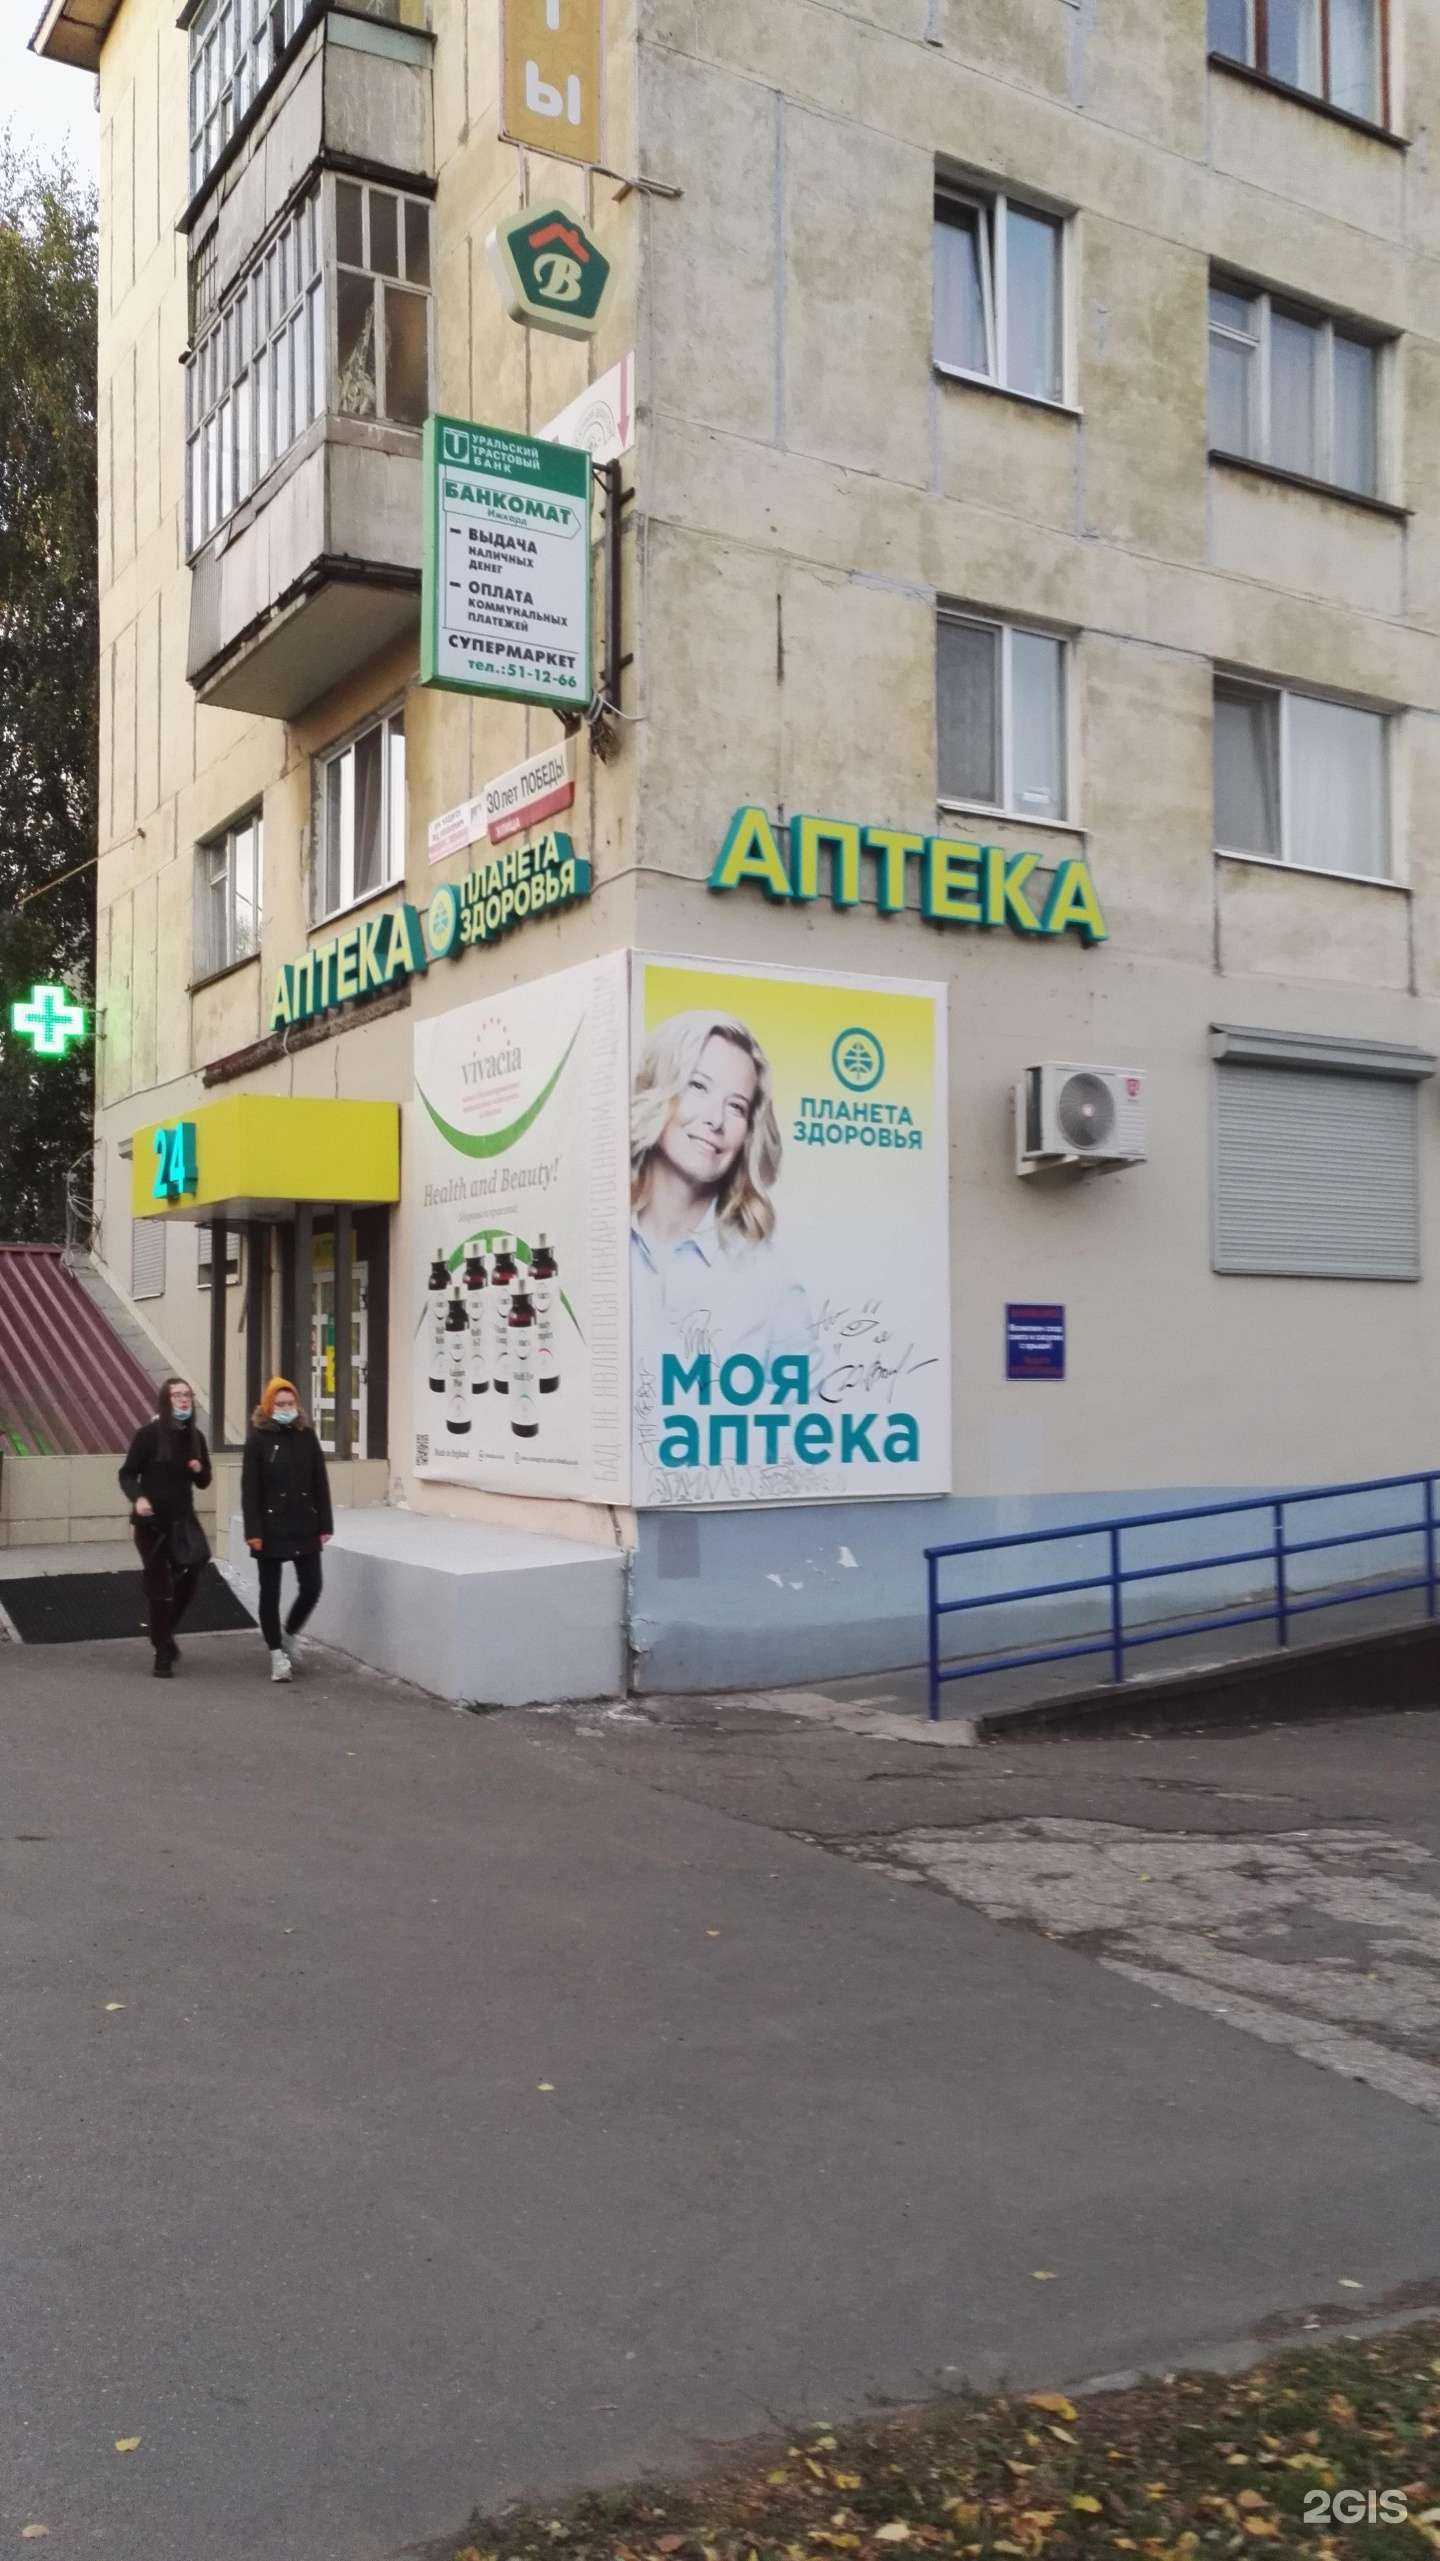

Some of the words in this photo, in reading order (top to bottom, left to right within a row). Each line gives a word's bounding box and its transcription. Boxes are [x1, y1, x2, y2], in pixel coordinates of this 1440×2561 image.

[472, 433, 539, 459] УРАЛЬСКИЙ
[472, 446, 541, 470] ТРАСТОВЫЙ
[474, 458, 512, 473] БАНК
[445, 481, 571, 525] БАНКОМАТ
[468, 528, 538, 555] ВЫДАЧА
[468, 545, 535, 568] НАЛИЧНЫХ
[468, 559, 503, 574] ДЕНЕГ
[468, 580, 534, 605] ОПЛАТА
[468, 598, 569, 627] КОММУНАЛЬНЫХ
[468, 612, 529, 632] ПЛАТЕЖЕЙ
[448, 634, 576, 669] СУПЕРМАРКЕТ
[486, 789, 501, 814] 30
[501, 784, 519, 809] лет
[520, 754, 566, 797] ПОБЕДЫ
[460, 831, 566, 907] ПЛАНЕТА
[708, 806, 1109, 942] АПТЕКА
[460, 859, 581, 943] ЗДОРОВЬЯ
[270, 903, 422, 1031] АПТЕКА
[800, 1097, 913, 1126] ПЛАНЕТА
[793, 1120, 923, 1150] ЗДОРОВЬЯ
[152, 1121, 193, 1199] 24
[424, 1176, 467, 1207] Health
[470, 1168, 498, 1198] and
[500, 1157, 560, 1191] Beauty!
[659, 1412, 920, 1468] аптека
